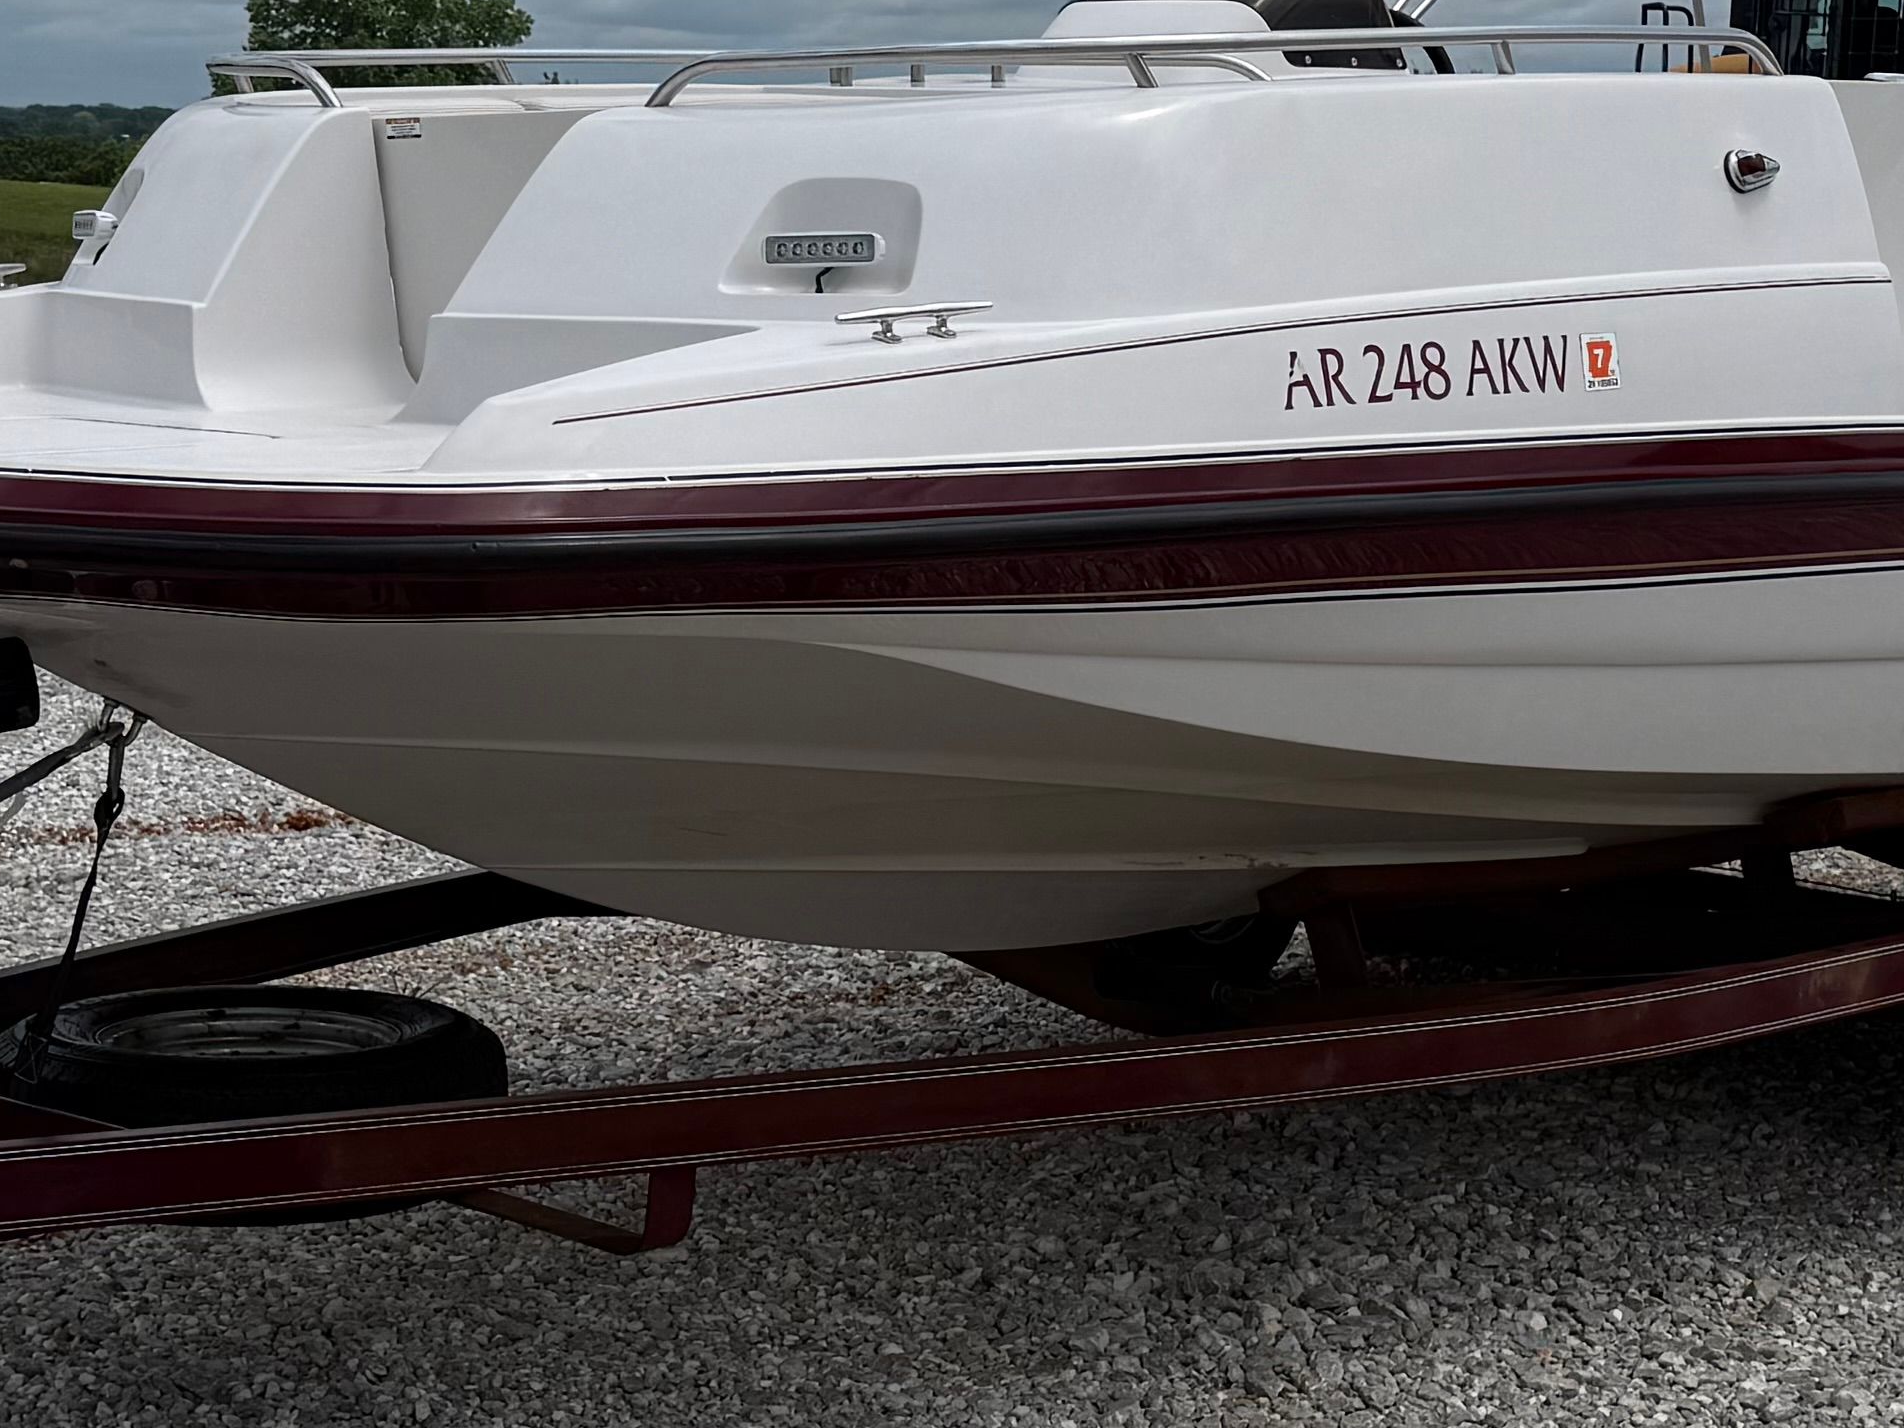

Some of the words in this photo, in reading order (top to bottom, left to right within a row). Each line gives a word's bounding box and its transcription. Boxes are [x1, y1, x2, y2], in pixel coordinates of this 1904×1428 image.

[1284, 348, 1357, 411] AR
[1362, 341, 1452, 404] 248
[1465, 334, 1568, 397] AKW
